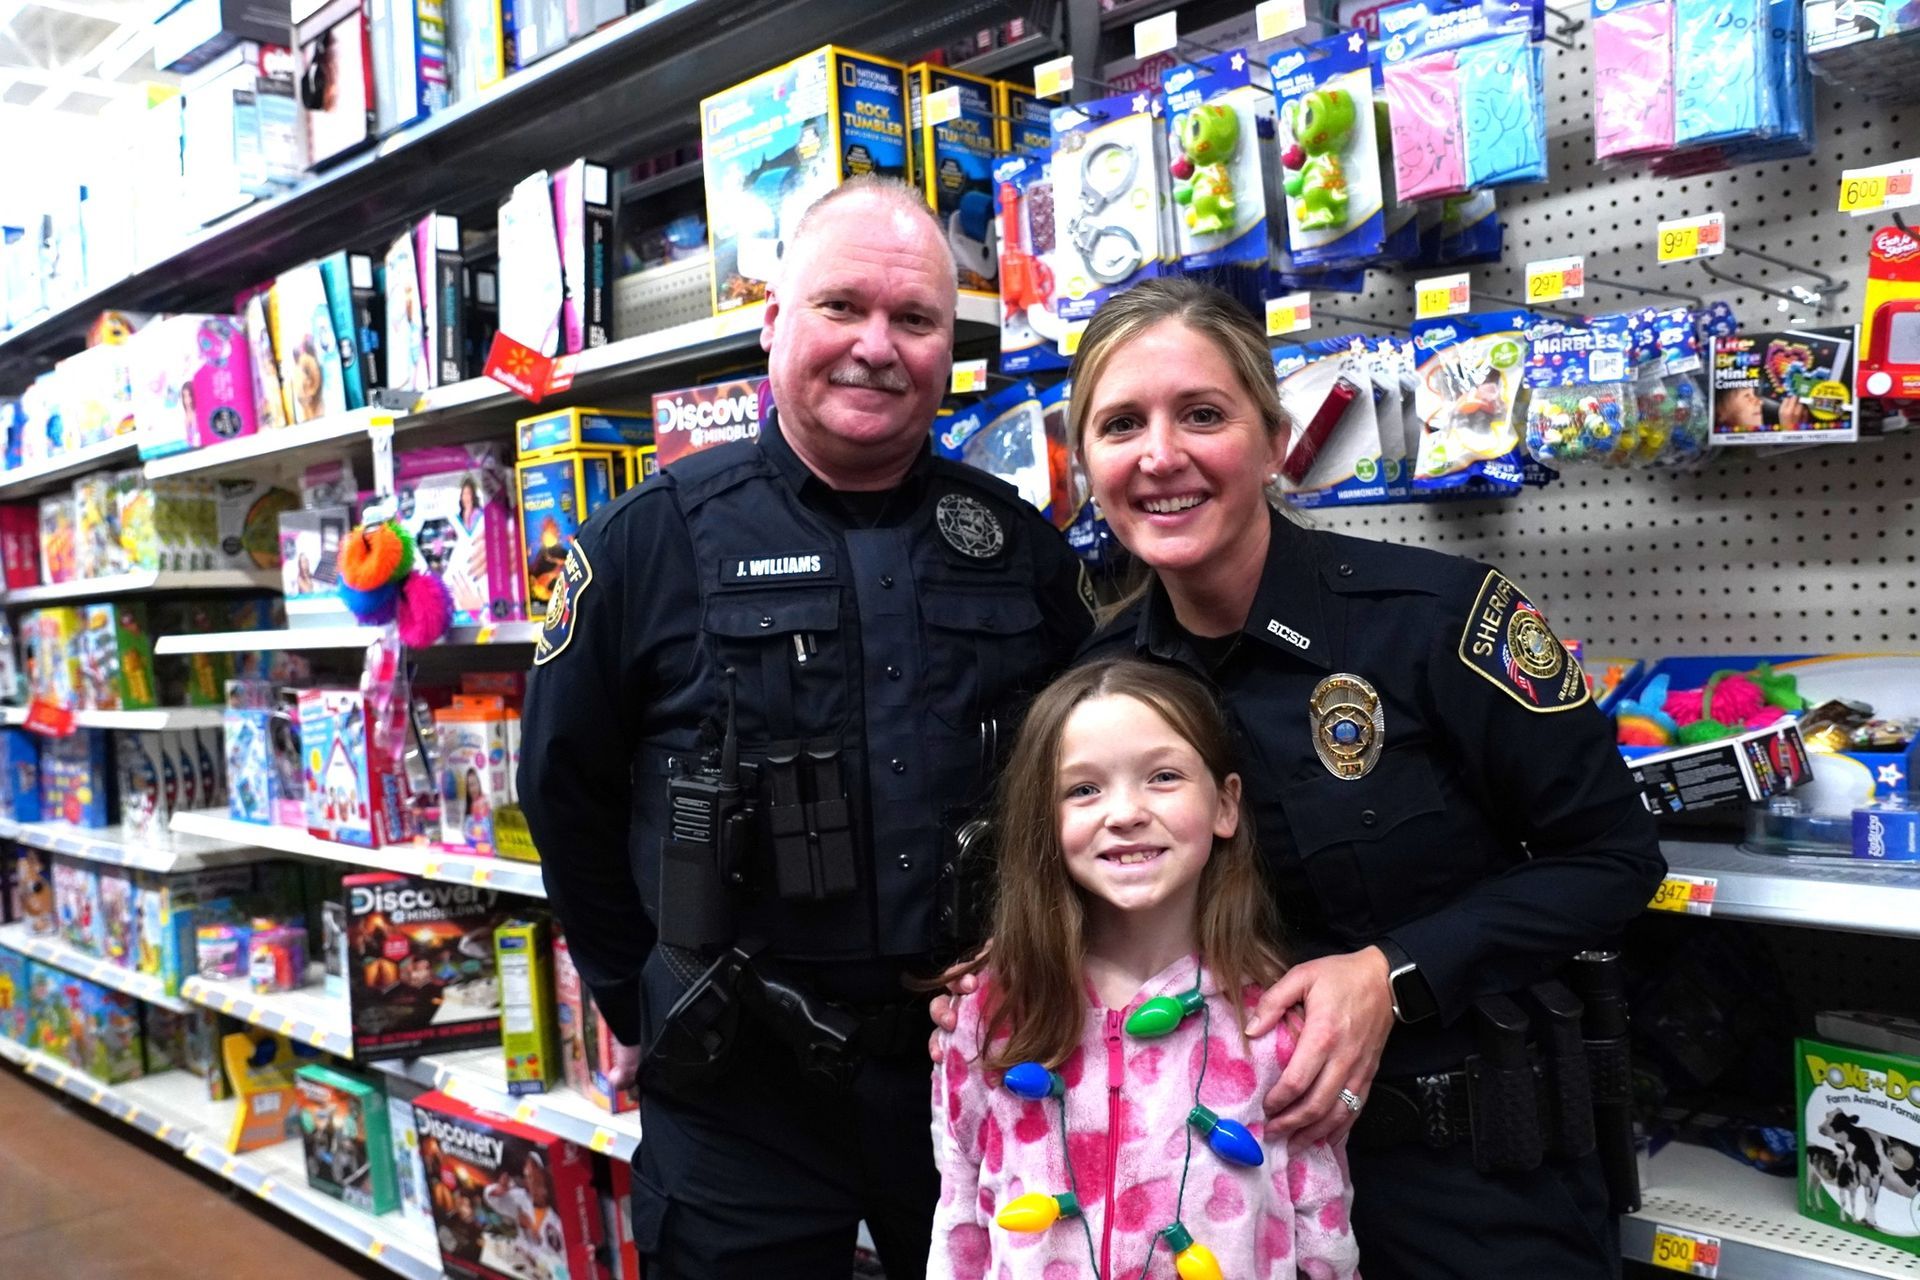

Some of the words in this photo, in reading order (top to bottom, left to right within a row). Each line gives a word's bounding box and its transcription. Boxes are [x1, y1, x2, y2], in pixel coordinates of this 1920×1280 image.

[856, 100, 889, 118] ROCK
[843, 112, 903, 137] TUMBLER
[1533, 332, 1619, 354] MARBLES
[1715, 379, 1760, 390] Connect
[657, 393, 759, 434] Discove
[1338, 487, 1385, 499] HARMONICA
[737, 561, 747, 577] J.
[750, 555, 821, 576] WILLIAMS
[1473, 580, 1514, 656] SHERIFF
[1267, 619, 1311, 650] BCSD
[351, 885, 499, 916] Discovery
[1654, 883, 1685, 904] 347
[1826, 1094, 1851, 1104] Farm
[1854, 1094, 1889, 1110] Animal
[414, 1108, 504, 1166] Discovery
